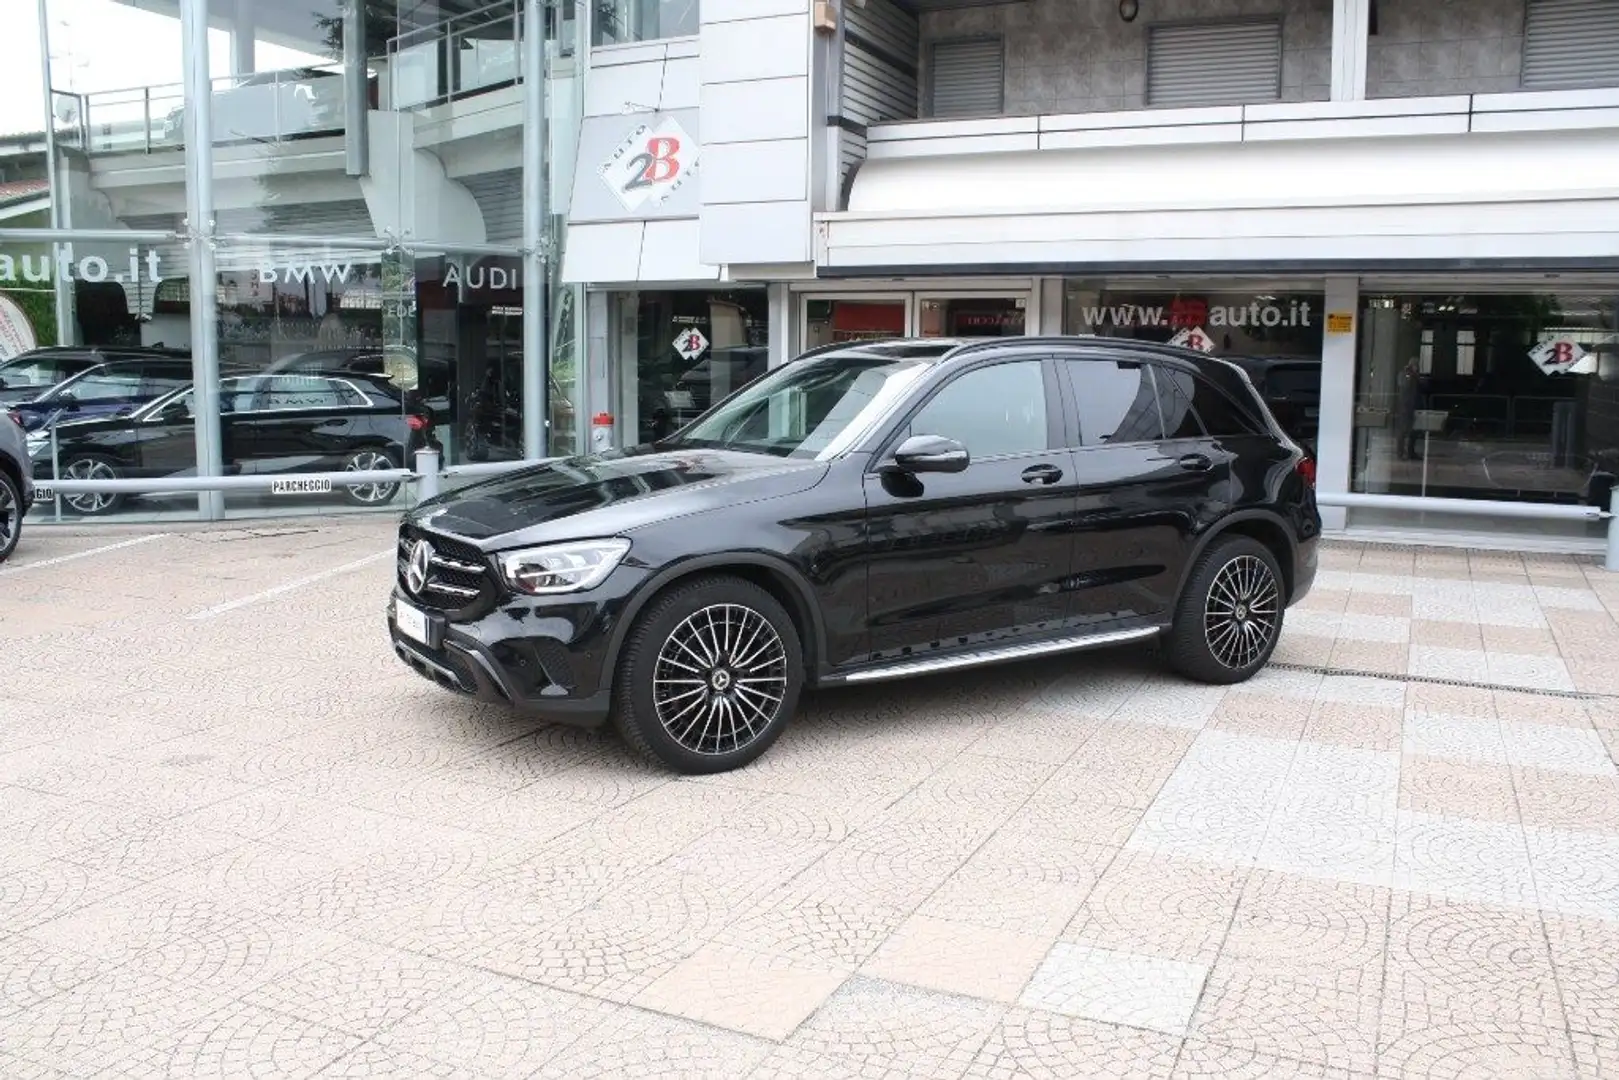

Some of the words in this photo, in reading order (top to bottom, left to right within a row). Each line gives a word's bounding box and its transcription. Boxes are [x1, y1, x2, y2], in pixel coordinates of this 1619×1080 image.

[622, 137, 680, 193] 2B
[259, 260, 350, 284] BMW
[443, 264, 517, 290] AUDI
[682, 334, 701, 352] 2B
[1542, 342, 1573, 366] 2B
[273, 480, 330, 493] PARCHEGGIO
